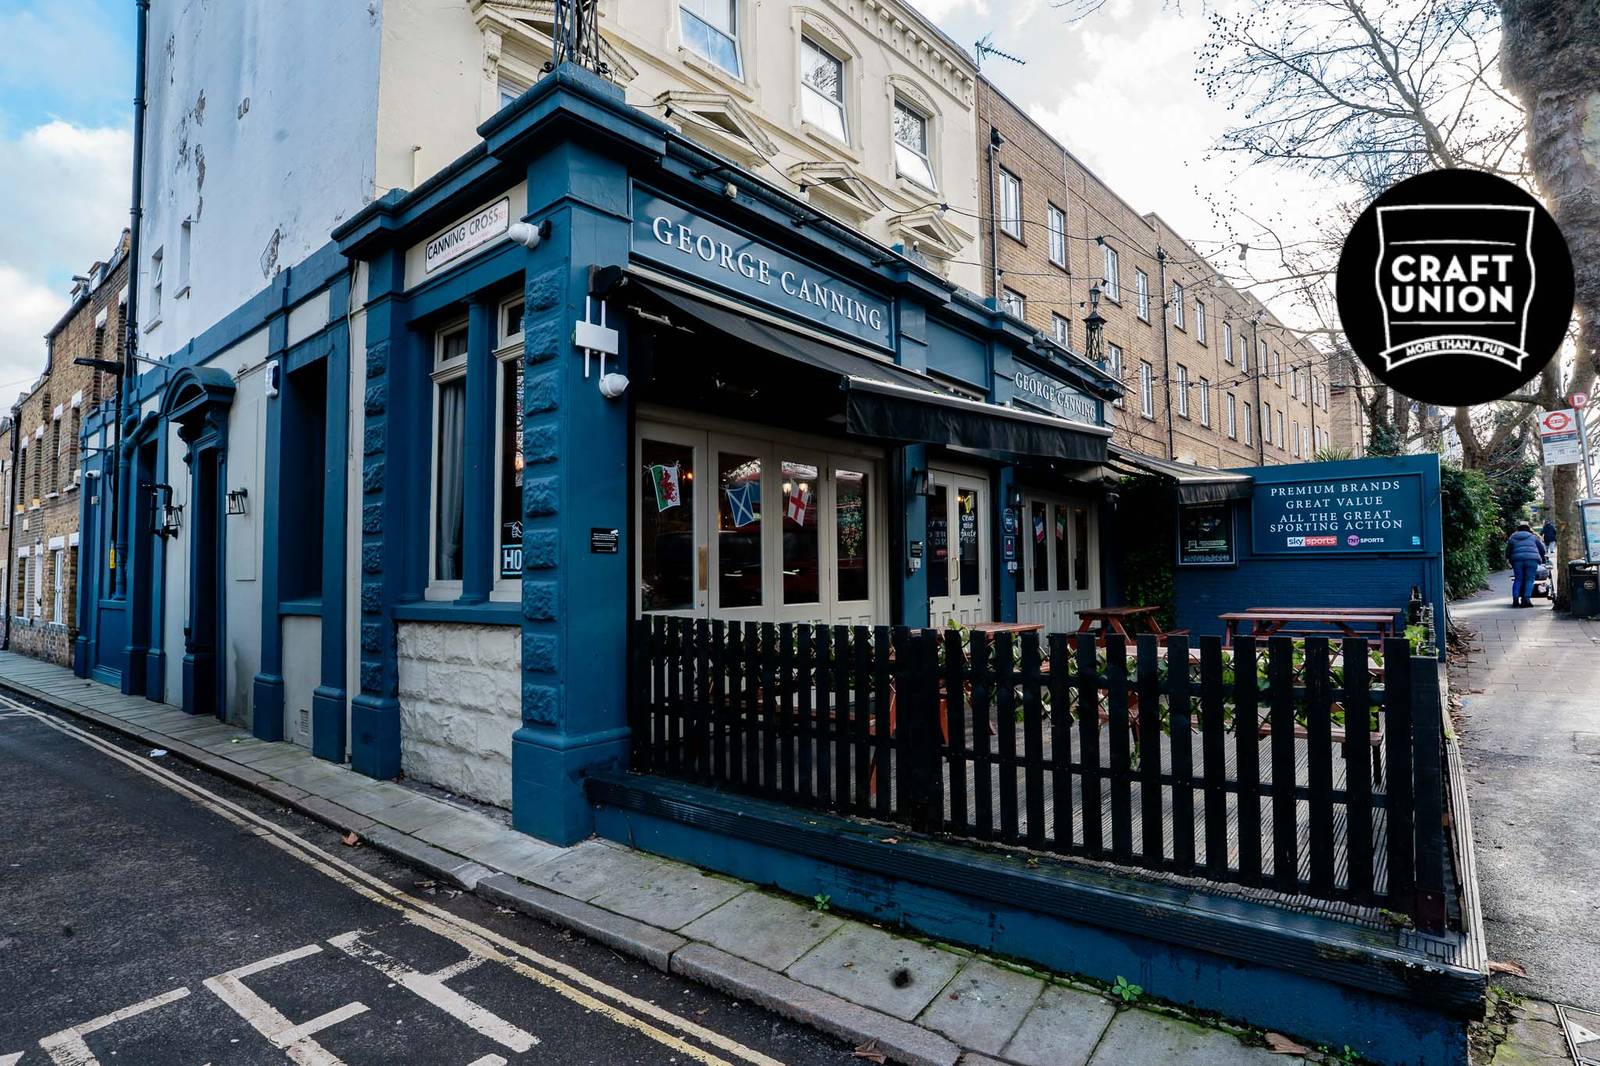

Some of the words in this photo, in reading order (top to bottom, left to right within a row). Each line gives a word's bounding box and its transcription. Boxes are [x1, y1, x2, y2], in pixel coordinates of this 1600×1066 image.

[428, 227, 465, 260] CANNING
[469, 207, 498, 236] CROSS
[652, 215, 770, 286] GEORGE
[780, 270, 882, 331] CANNING
[1015, 371, 1055, 402] GEORGE
[1057, 391, 1096, 421] CANNING
[1270, 484, 1335, 497] PREMIUM
[1341, 480, 1400, 493] BRANDS
[1286, 498, 1331, 509] GREAT
[1336, 496, 1384, 507] VALUE
[1280, 513, 1305, 523] ALL
[1309, 512, 1338, 522] THE
[1343, 510, 1392, 521] GREAT
[1270, 521, 1339, 533] SPORTING
[1345, 519, 1403, 531] ACTION
[1288, 537, 1304, 547] sky
[1306, 536, 1337, 546] sports
